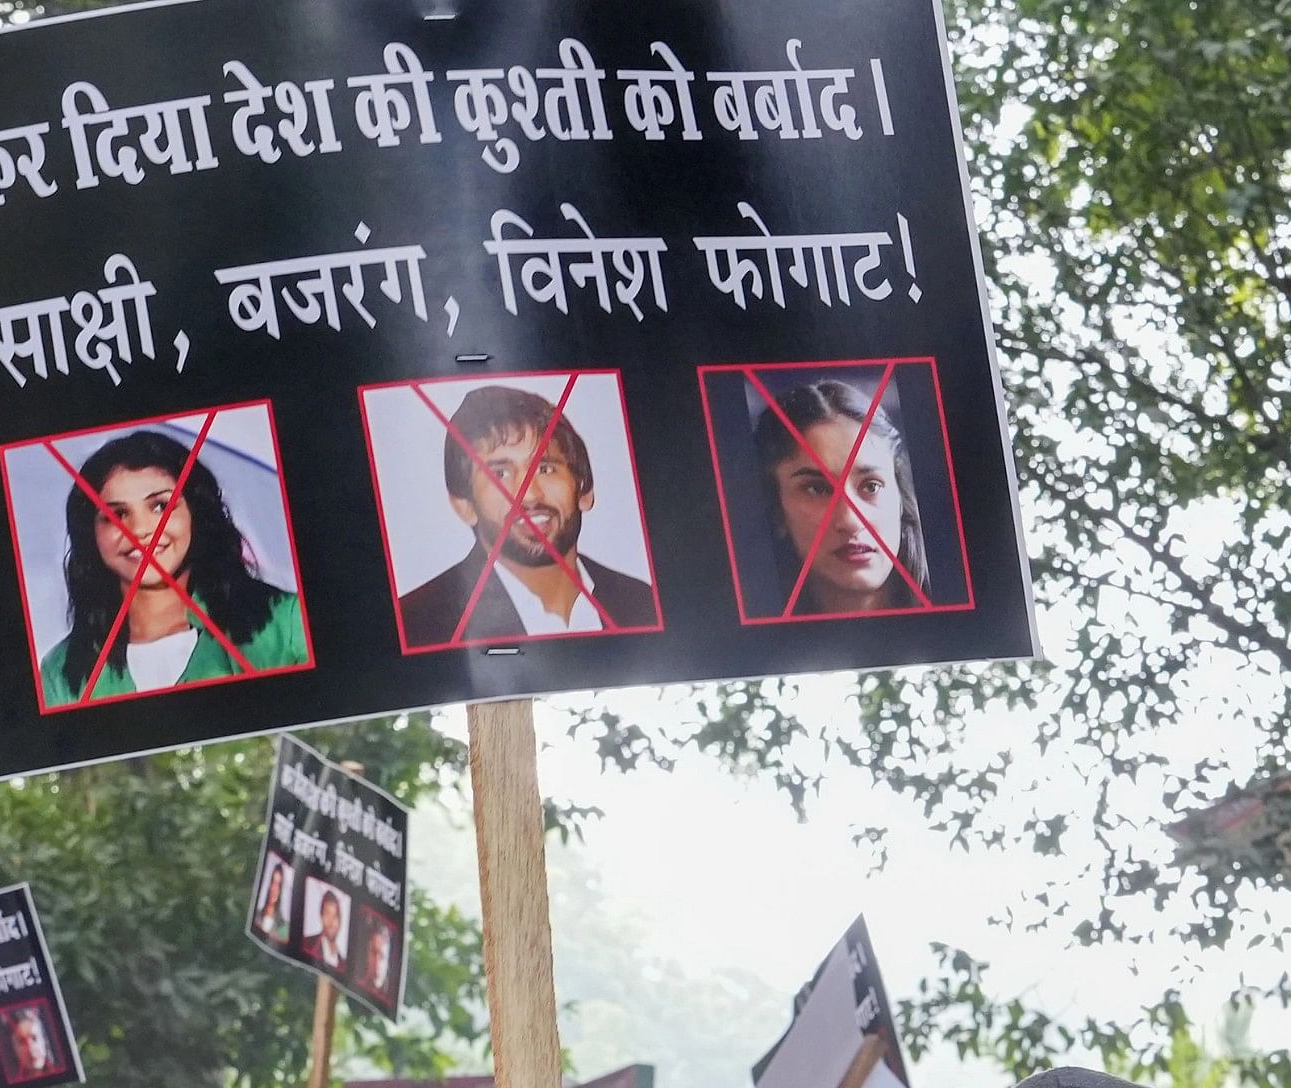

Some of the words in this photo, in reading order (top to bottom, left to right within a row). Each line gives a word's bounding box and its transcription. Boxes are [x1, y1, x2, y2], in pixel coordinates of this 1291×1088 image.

[62, 81, 219, 190] दिया
[223, 60, 342, 164] देश
[346, 42, 442, 148] की
[446, 38, 613, 173] कुश्ती
[617, 41, 703, 141] को
[213, 220, 460, 337] बजरंग,
[483, 202, 668, 322] विनेश
[693, 201, 923, 311] फोगाट!
